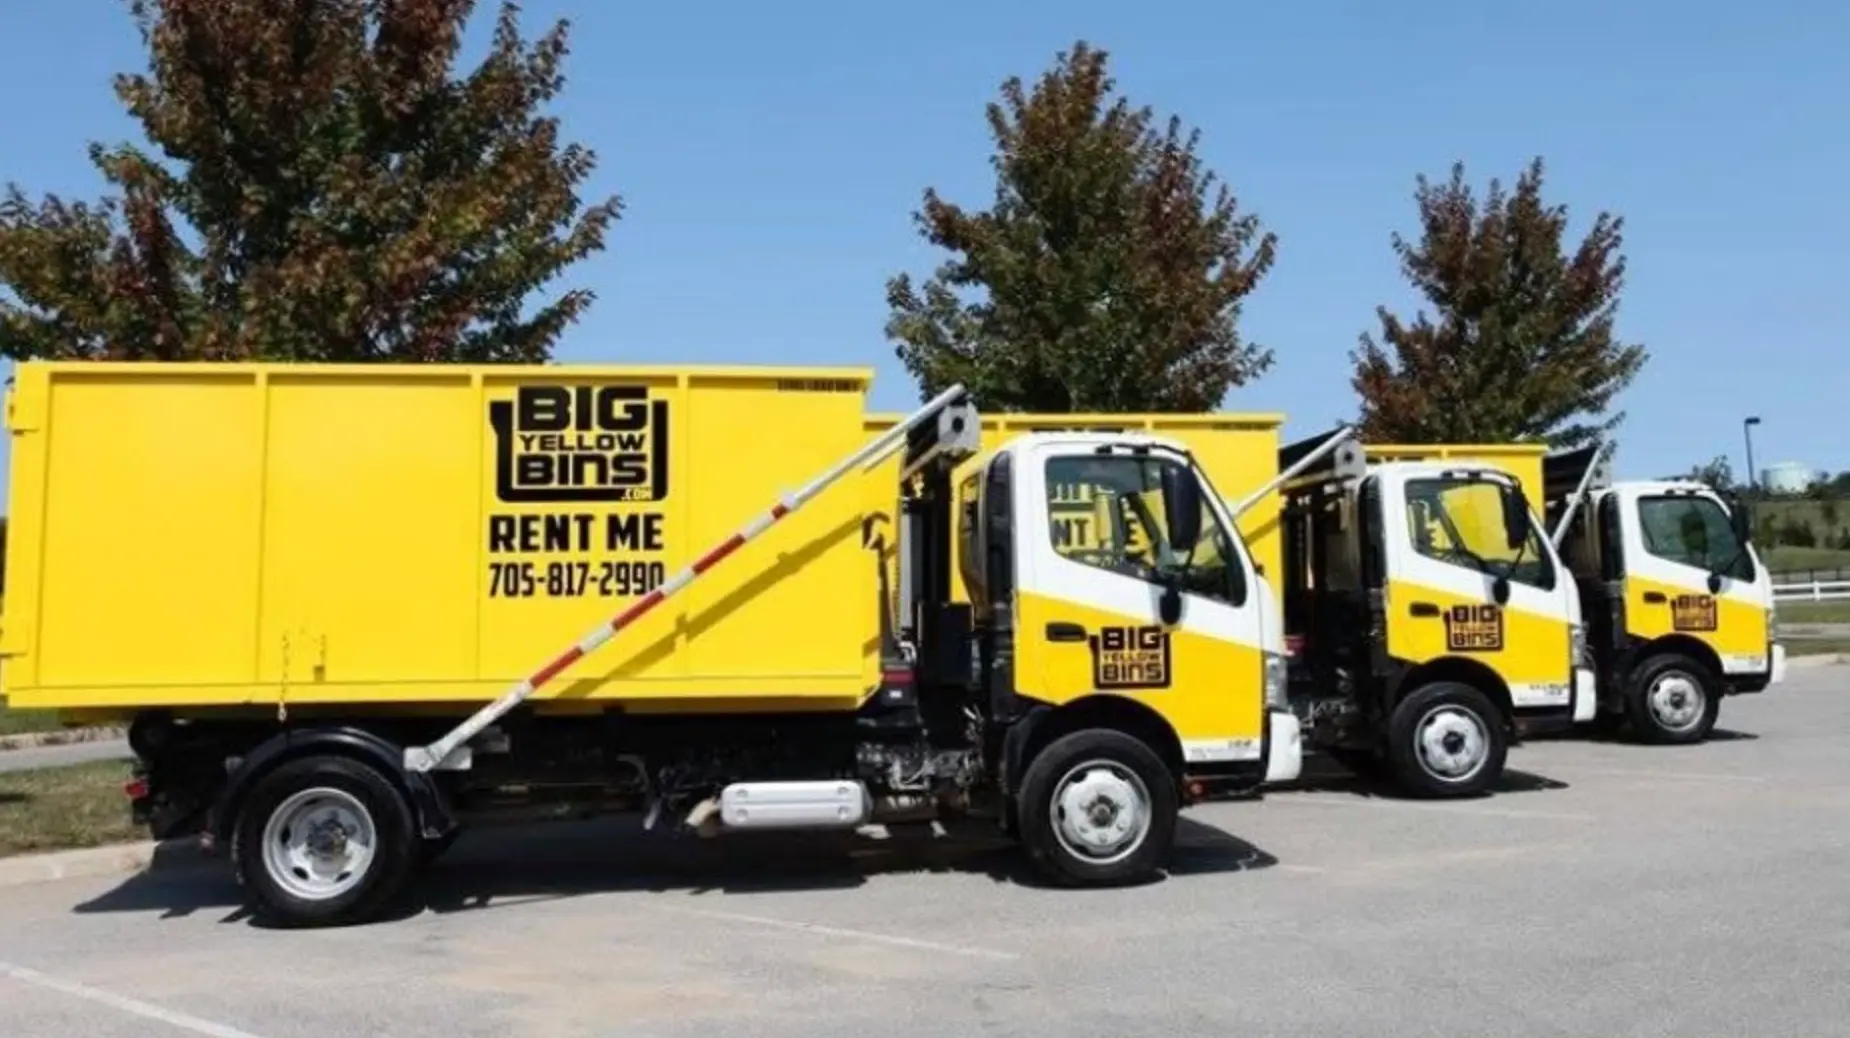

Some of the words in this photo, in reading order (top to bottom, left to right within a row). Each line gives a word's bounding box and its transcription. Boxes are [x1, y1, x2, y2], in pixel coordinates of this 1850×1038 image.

[518, 385, 648, 431] BIG
[518, 434, 645, 450] YELLOW
[517, 454, 647, 485] BINS
[489, 513, 595, 552] RENT
[606, 513, 664, 551] ME
[489, 562, 664, 598] 705-817-2990
[1453, 605, 1500, 621] BIG
[1101, 627, 1161, 650] BIG
[1103, 663, 1161, 680] BINS
